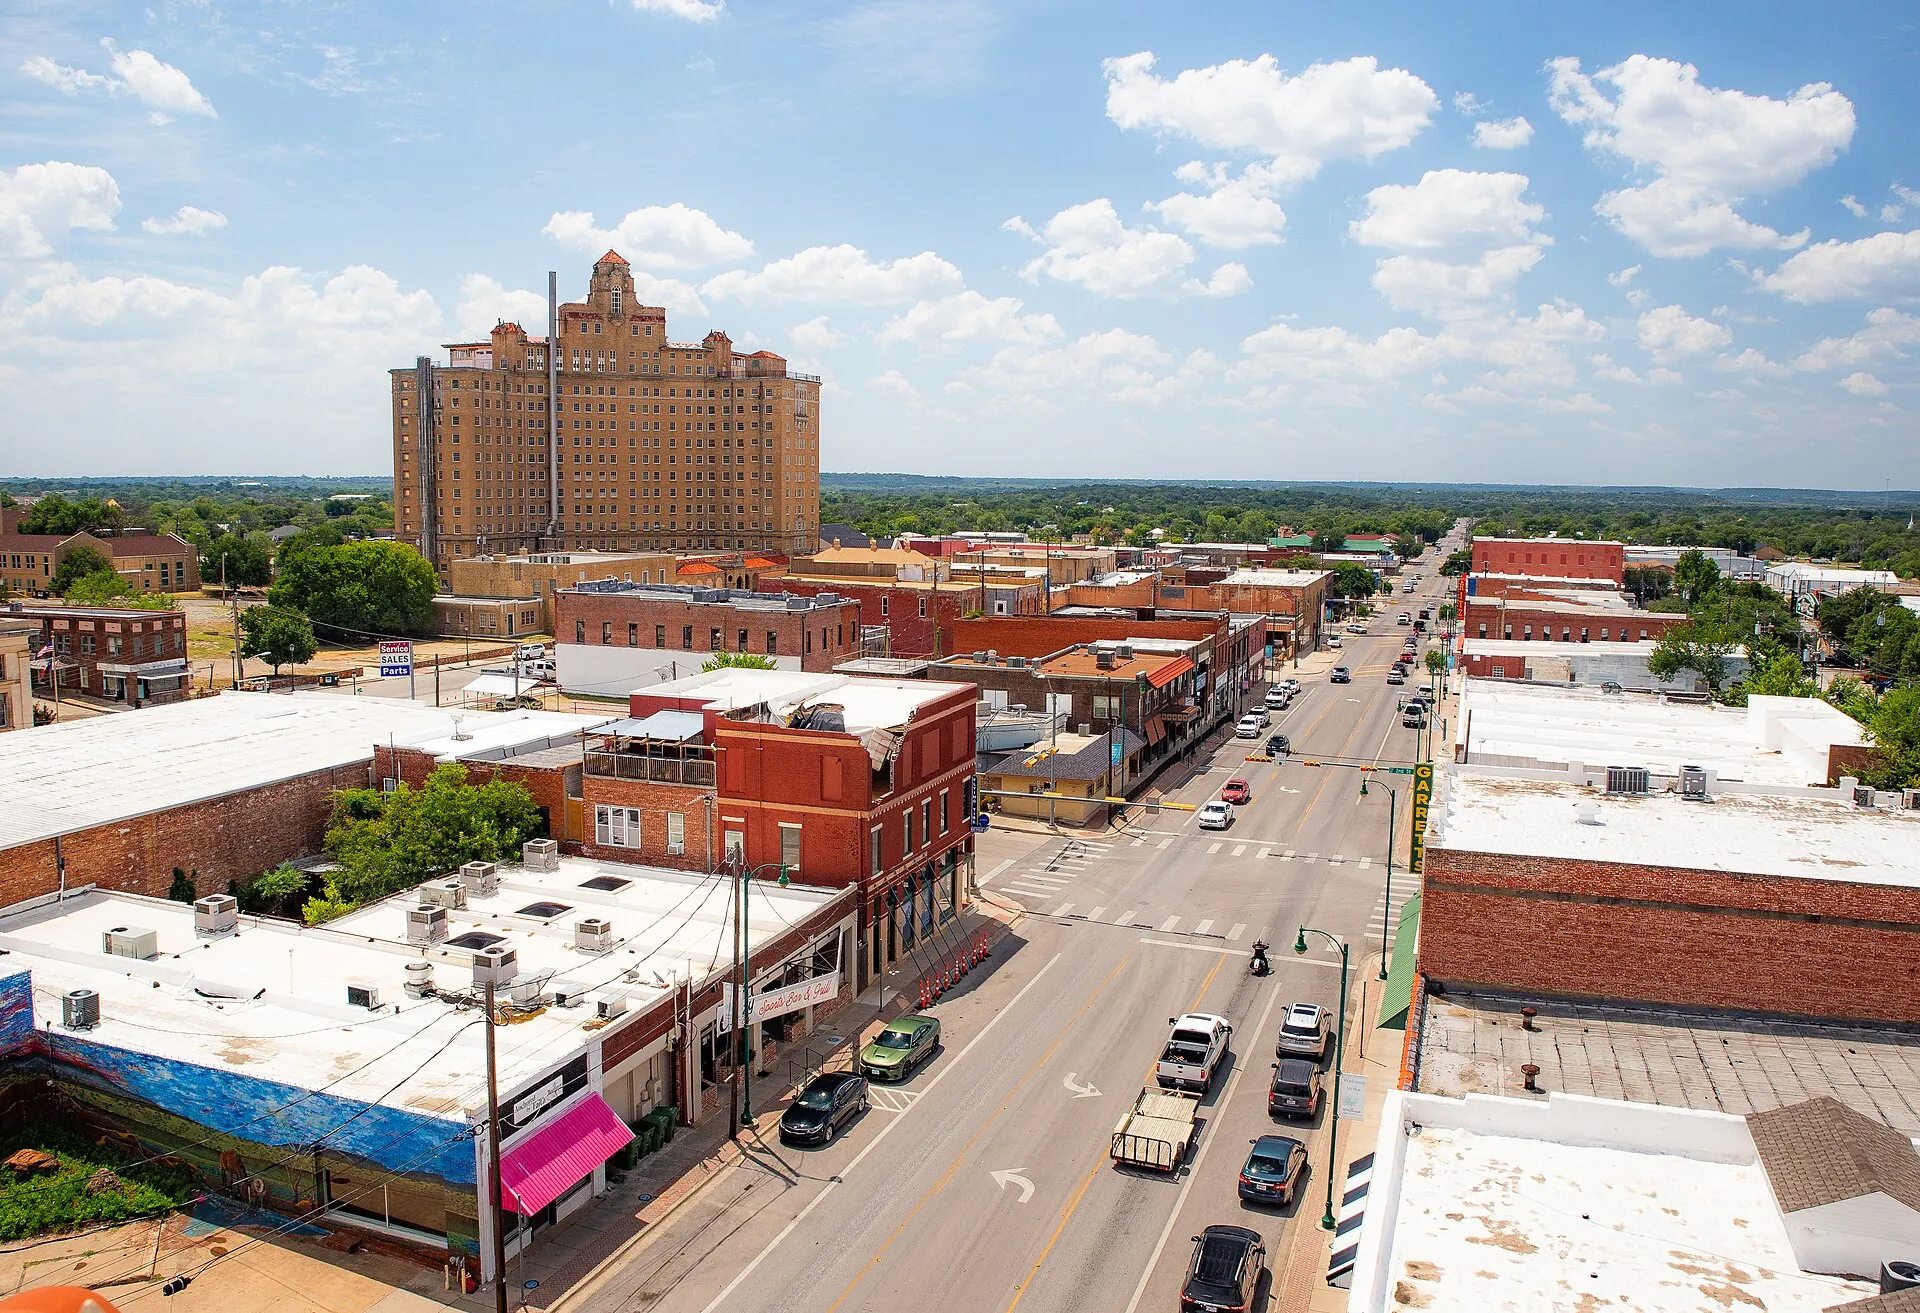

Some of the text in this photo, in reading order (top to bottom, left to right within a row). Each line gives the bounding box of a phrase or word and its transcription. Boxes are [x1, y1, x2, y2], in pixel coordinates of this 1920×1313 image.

[381, 645, 409, 653] Service
[381, 655, 409, 664] SALES
[382, 667, 408, 675] Parts
[1413, 766, 1431, 872] GARRETTS
[758, 979, 832, 1018] Sports Bar & Grill
